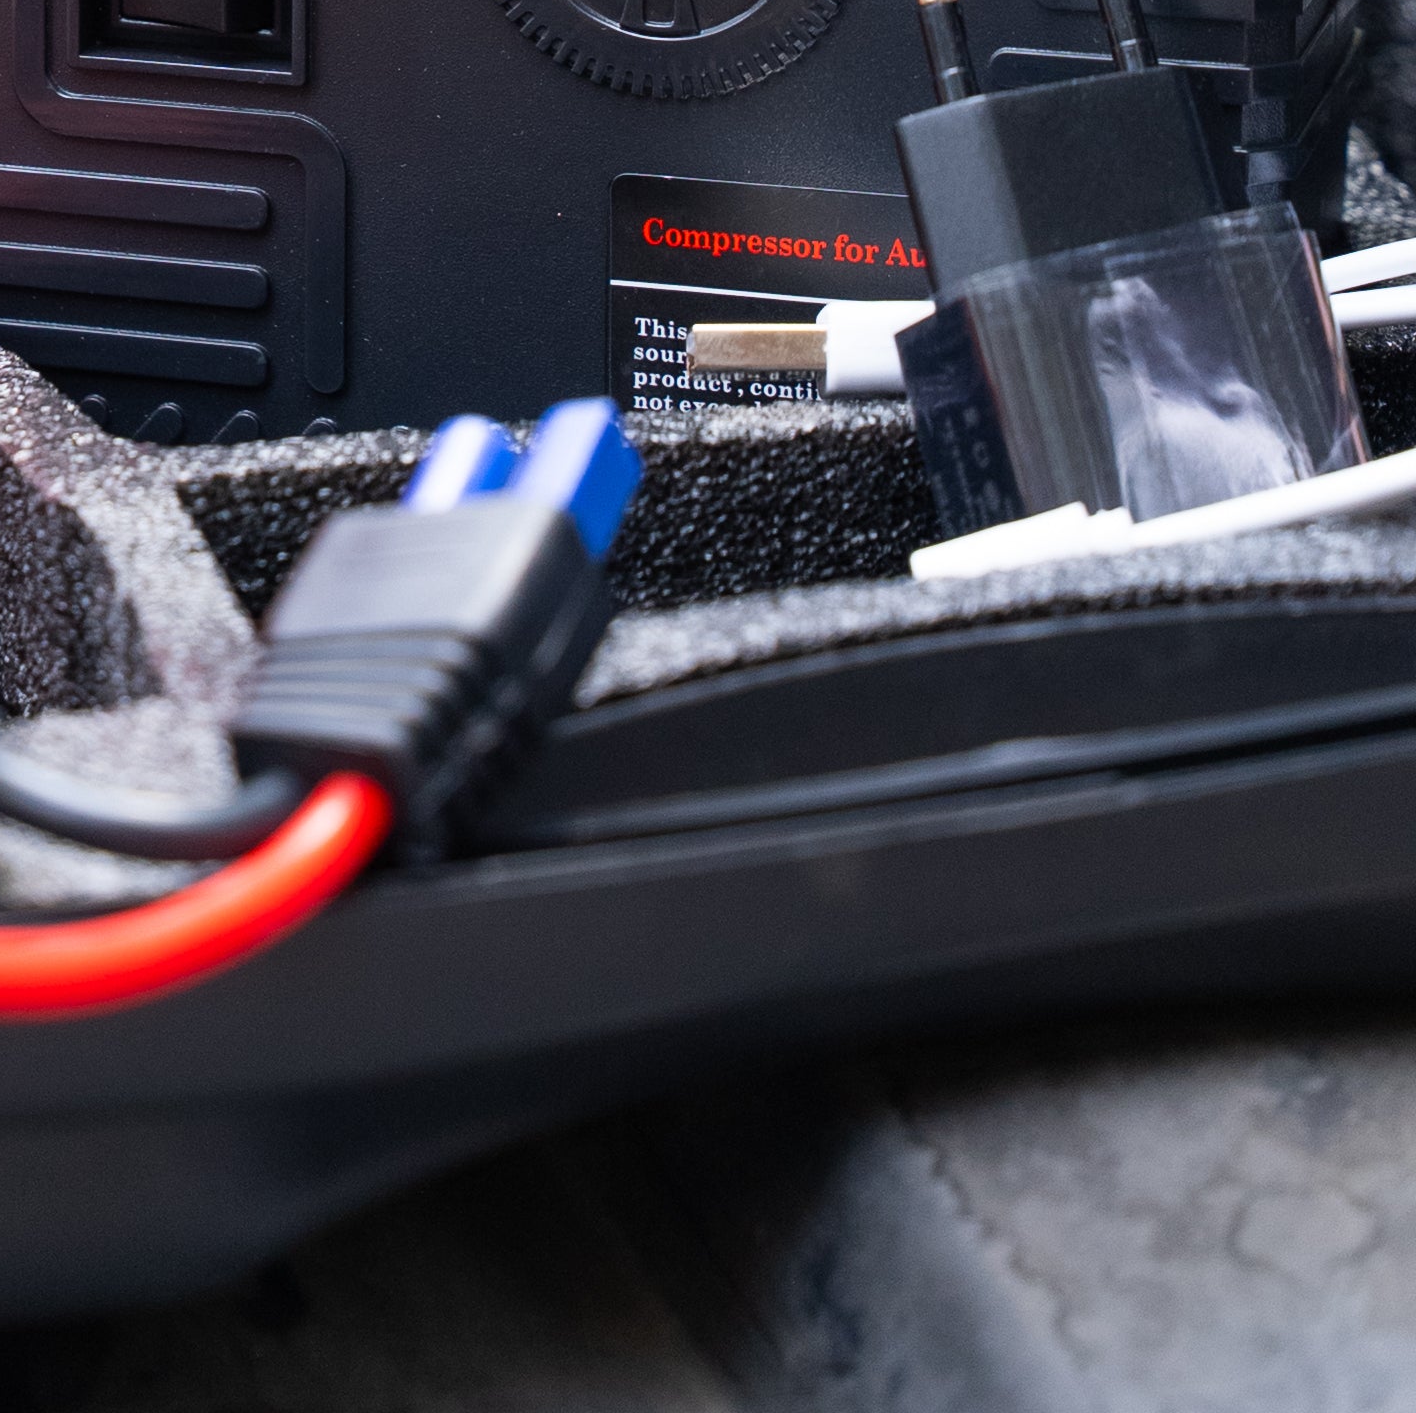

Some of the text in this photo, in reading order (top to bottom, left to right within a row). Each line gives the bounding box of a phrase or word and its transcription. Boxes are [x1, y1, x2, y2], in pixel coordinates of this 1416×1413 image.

[641, 217, 827, 260] Compressor
[833, 233, 880, 264] for
[634, 317, 688, 341] This
[633, 394, 674, 412] not
